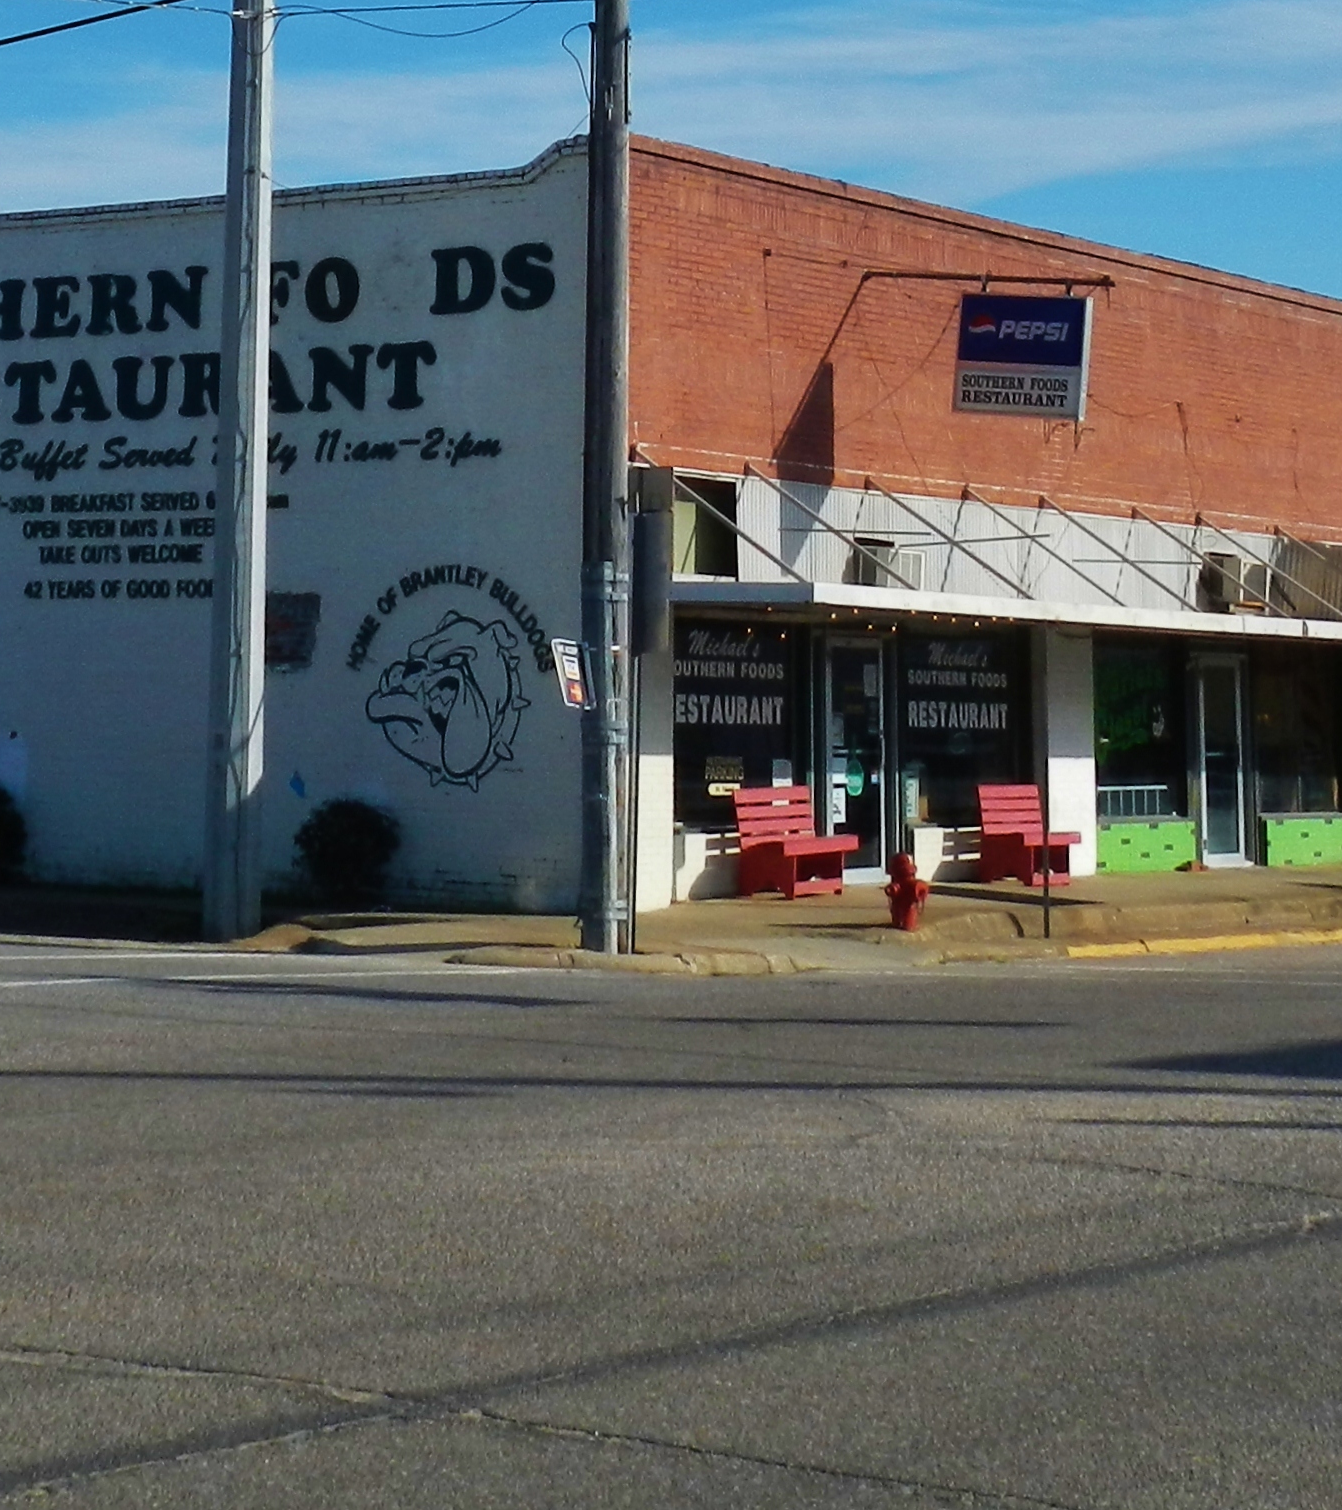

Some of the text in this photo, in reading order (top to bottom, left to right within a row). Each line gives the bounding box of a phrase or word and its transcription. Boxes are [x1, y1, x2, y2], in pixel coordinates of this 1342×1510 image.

[998, 319, 1069, 341] PEPSI
[961, 373, 1069, 393] SOUTHERN FOODS
[961, 389, 1068, 408] RESTAURANT
[98, 434, 196, 471] Served
[51, 493, 135, 513] BREAKFAST
[141, 491, 199, 511] SERVED
[22, 517, 215, 540] OPEN SEVEN DAYS A WEE
[39, 543, 203, 565] TAKE OUTS WELCOME
[23, 580, 42, 599] 42
[48, 579, 95, 599] YEARS
[100, 579, 121, 599] OF
[127, 579, 170, 599] GOOD
[345, 614, 381, 672] HOME
[376, 586, 398, 615] OF
[399, 564, 489, 598] BRANTLEY
[674, 659, 784, 680] OUTHERN FOODS
[907, 669, 1007, 688] SOUTHERN FOODS
[675, 693, 784, 725] ESTAURANT
[907, 700, 1008, 729] RESTAURANT
